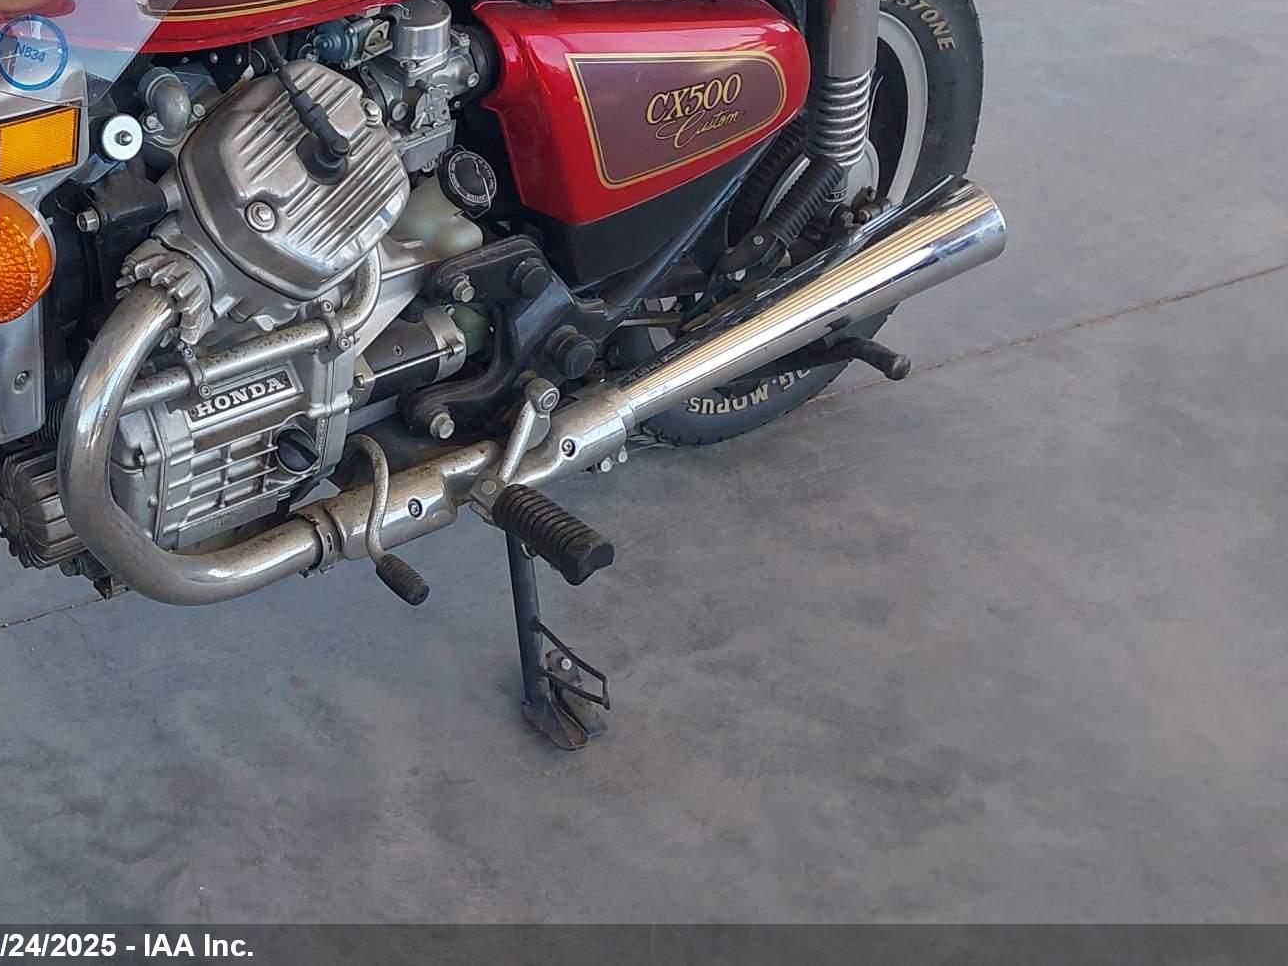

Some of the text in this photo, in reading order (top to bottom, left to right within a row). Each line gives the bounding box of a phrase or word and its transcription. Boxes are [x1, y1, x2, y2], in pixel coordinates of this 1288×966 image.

[14, 41, 46, 63] N834
[646, 73, 743, 126] CX500
[655, 110, 740, 149] Custom
[195, 377, 286, 417] HONDA
